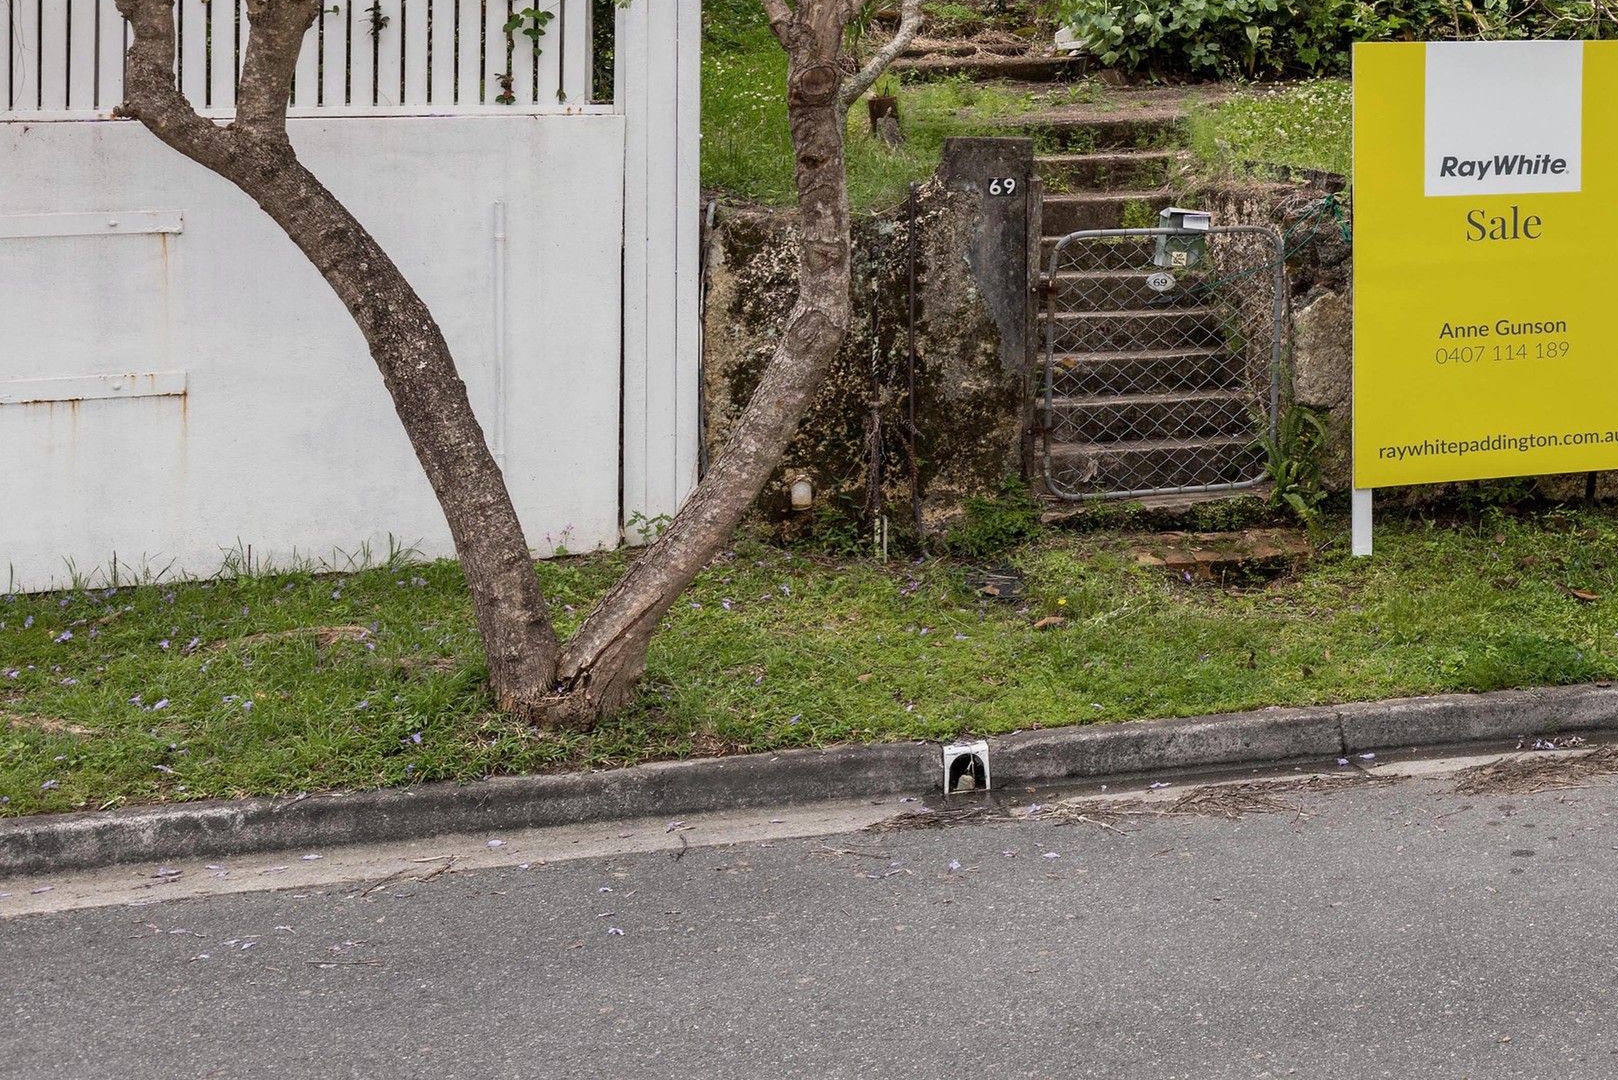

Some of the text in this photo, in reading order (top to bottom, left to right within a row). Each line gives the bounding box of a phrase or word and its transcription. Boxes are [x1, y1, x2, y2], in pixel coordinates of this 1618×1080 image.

[989, 178, 1016, 195] 69
[1466, 206, 1542, 241] Sale
[1153, 278, 1168, 287] 69
[1439, 320, 1567, 339] Anne Gunson
[1435, 341, 1570, 364] 0407 114 189
